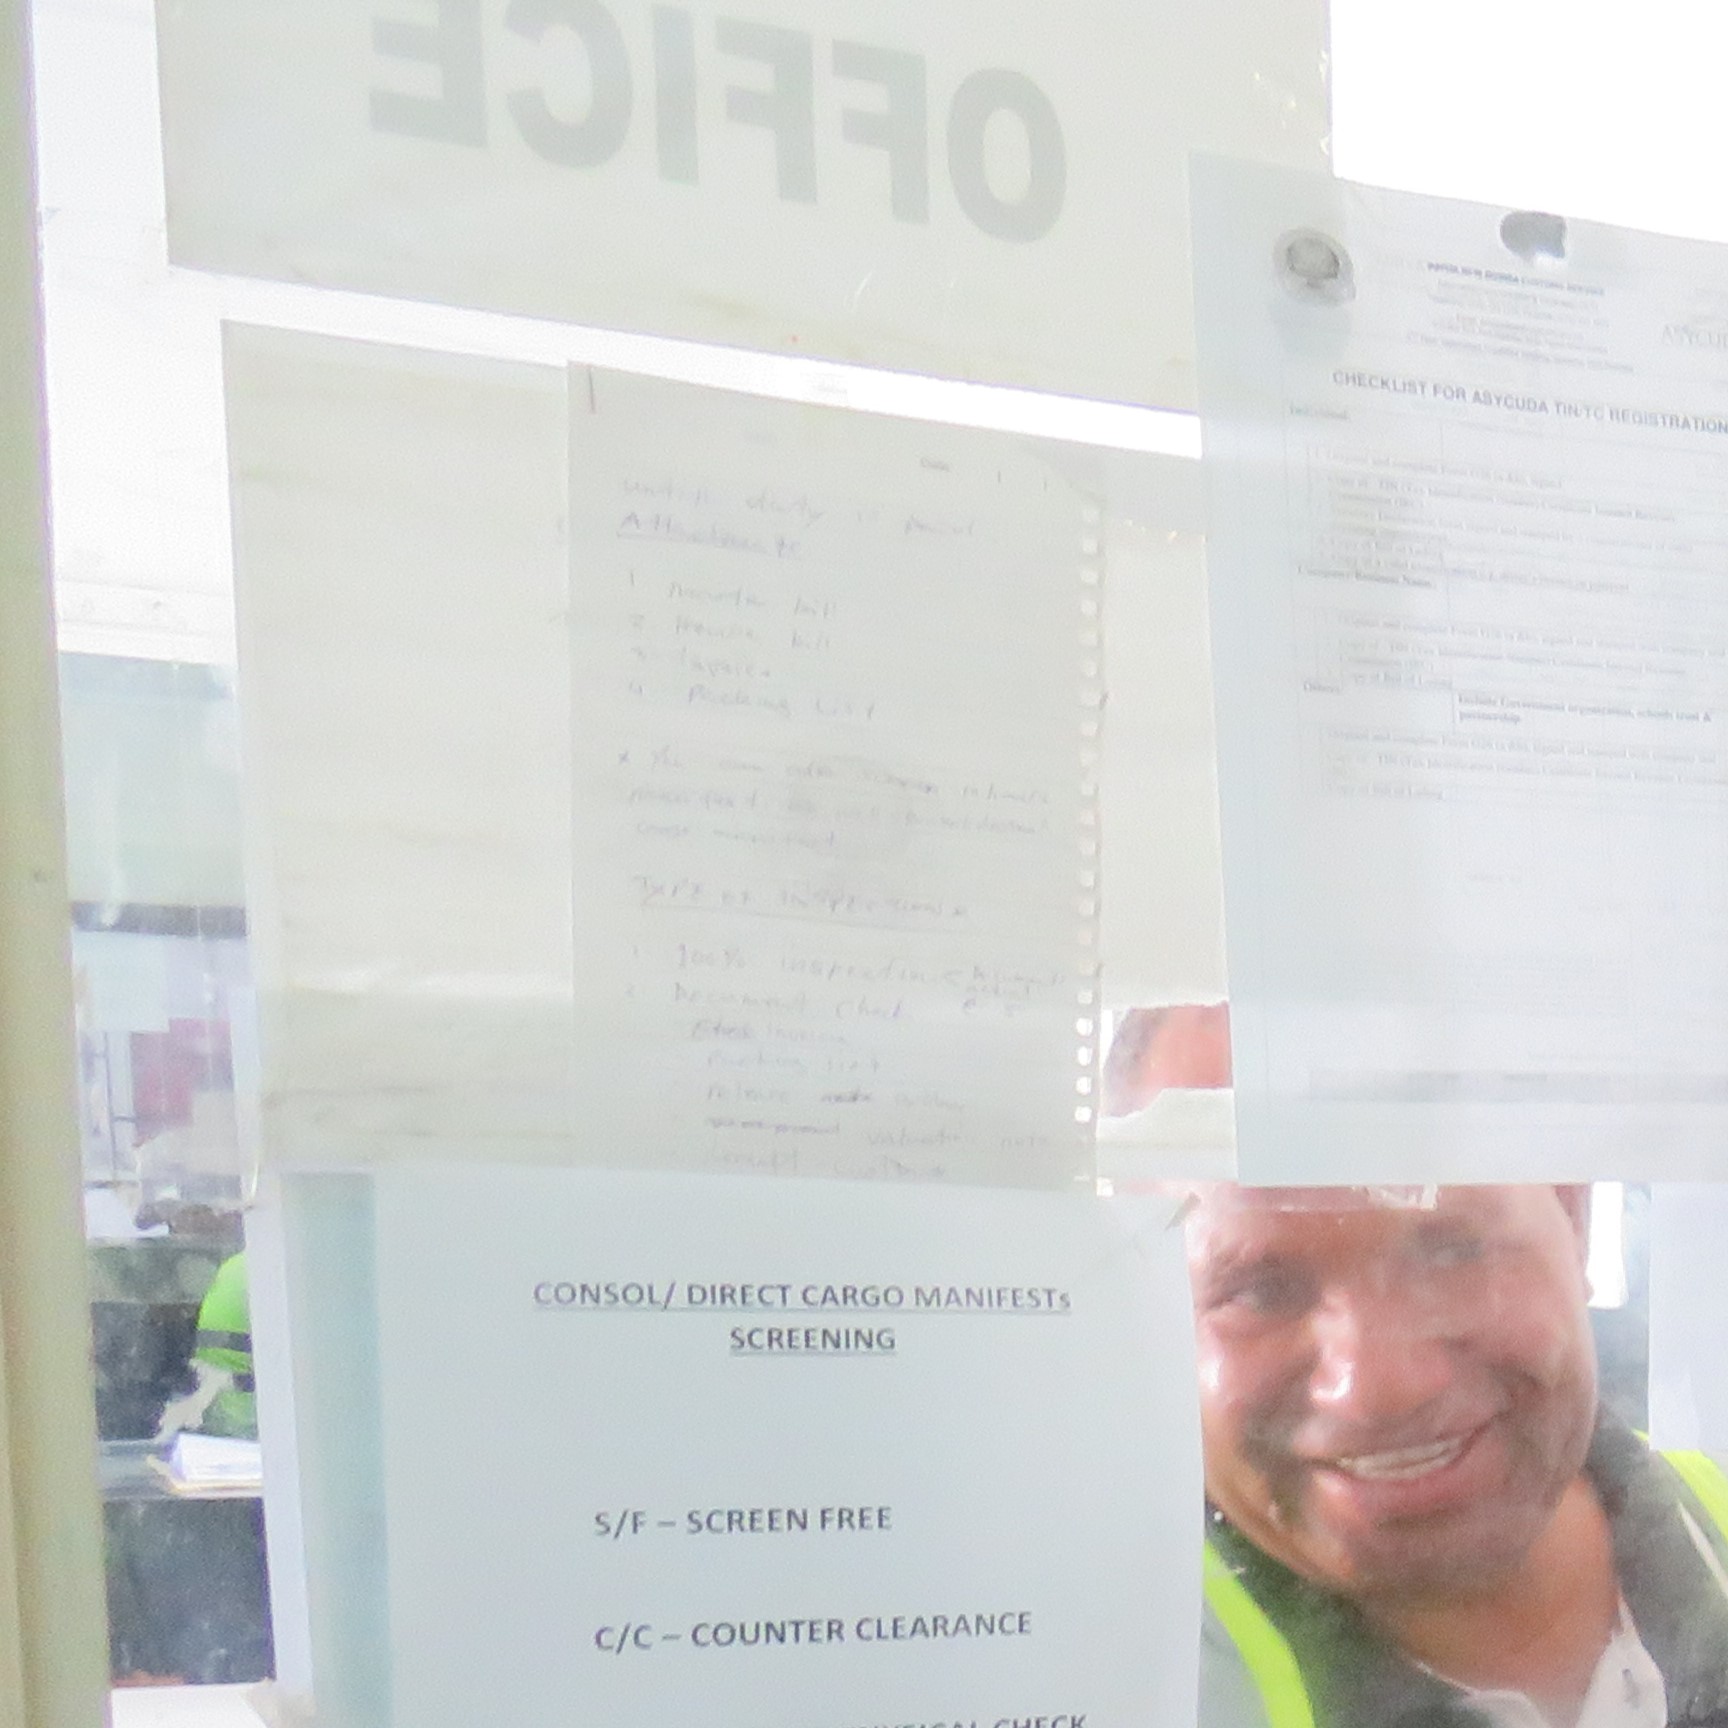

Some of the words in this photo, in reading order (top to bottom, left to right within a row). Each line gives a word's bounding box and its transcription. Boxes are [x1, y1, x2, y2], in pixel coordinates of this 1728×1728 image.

[1332, 370, 1426, 396] CHECKLIST
[1433, 381, 1467, 402] FOR
[1472, 390, 1549, 414] ASYCUDA
[687, 1284, 792, 1307] DIRECT
[801, 1285, 903, 1308] CARGO
[730, 1327, 897, 1351] SCREENING
[594, 1509, 647, 1539] S/F
[687, 1509, 808, 1535] SCREEN
[820, 1507, 892, 1531] FREE
[594, 1623, 653, 1654] C/C
[691, 1619, 845, 1647] COUNTER
[856, 1611, 1033, 1642] CLEARANCE
